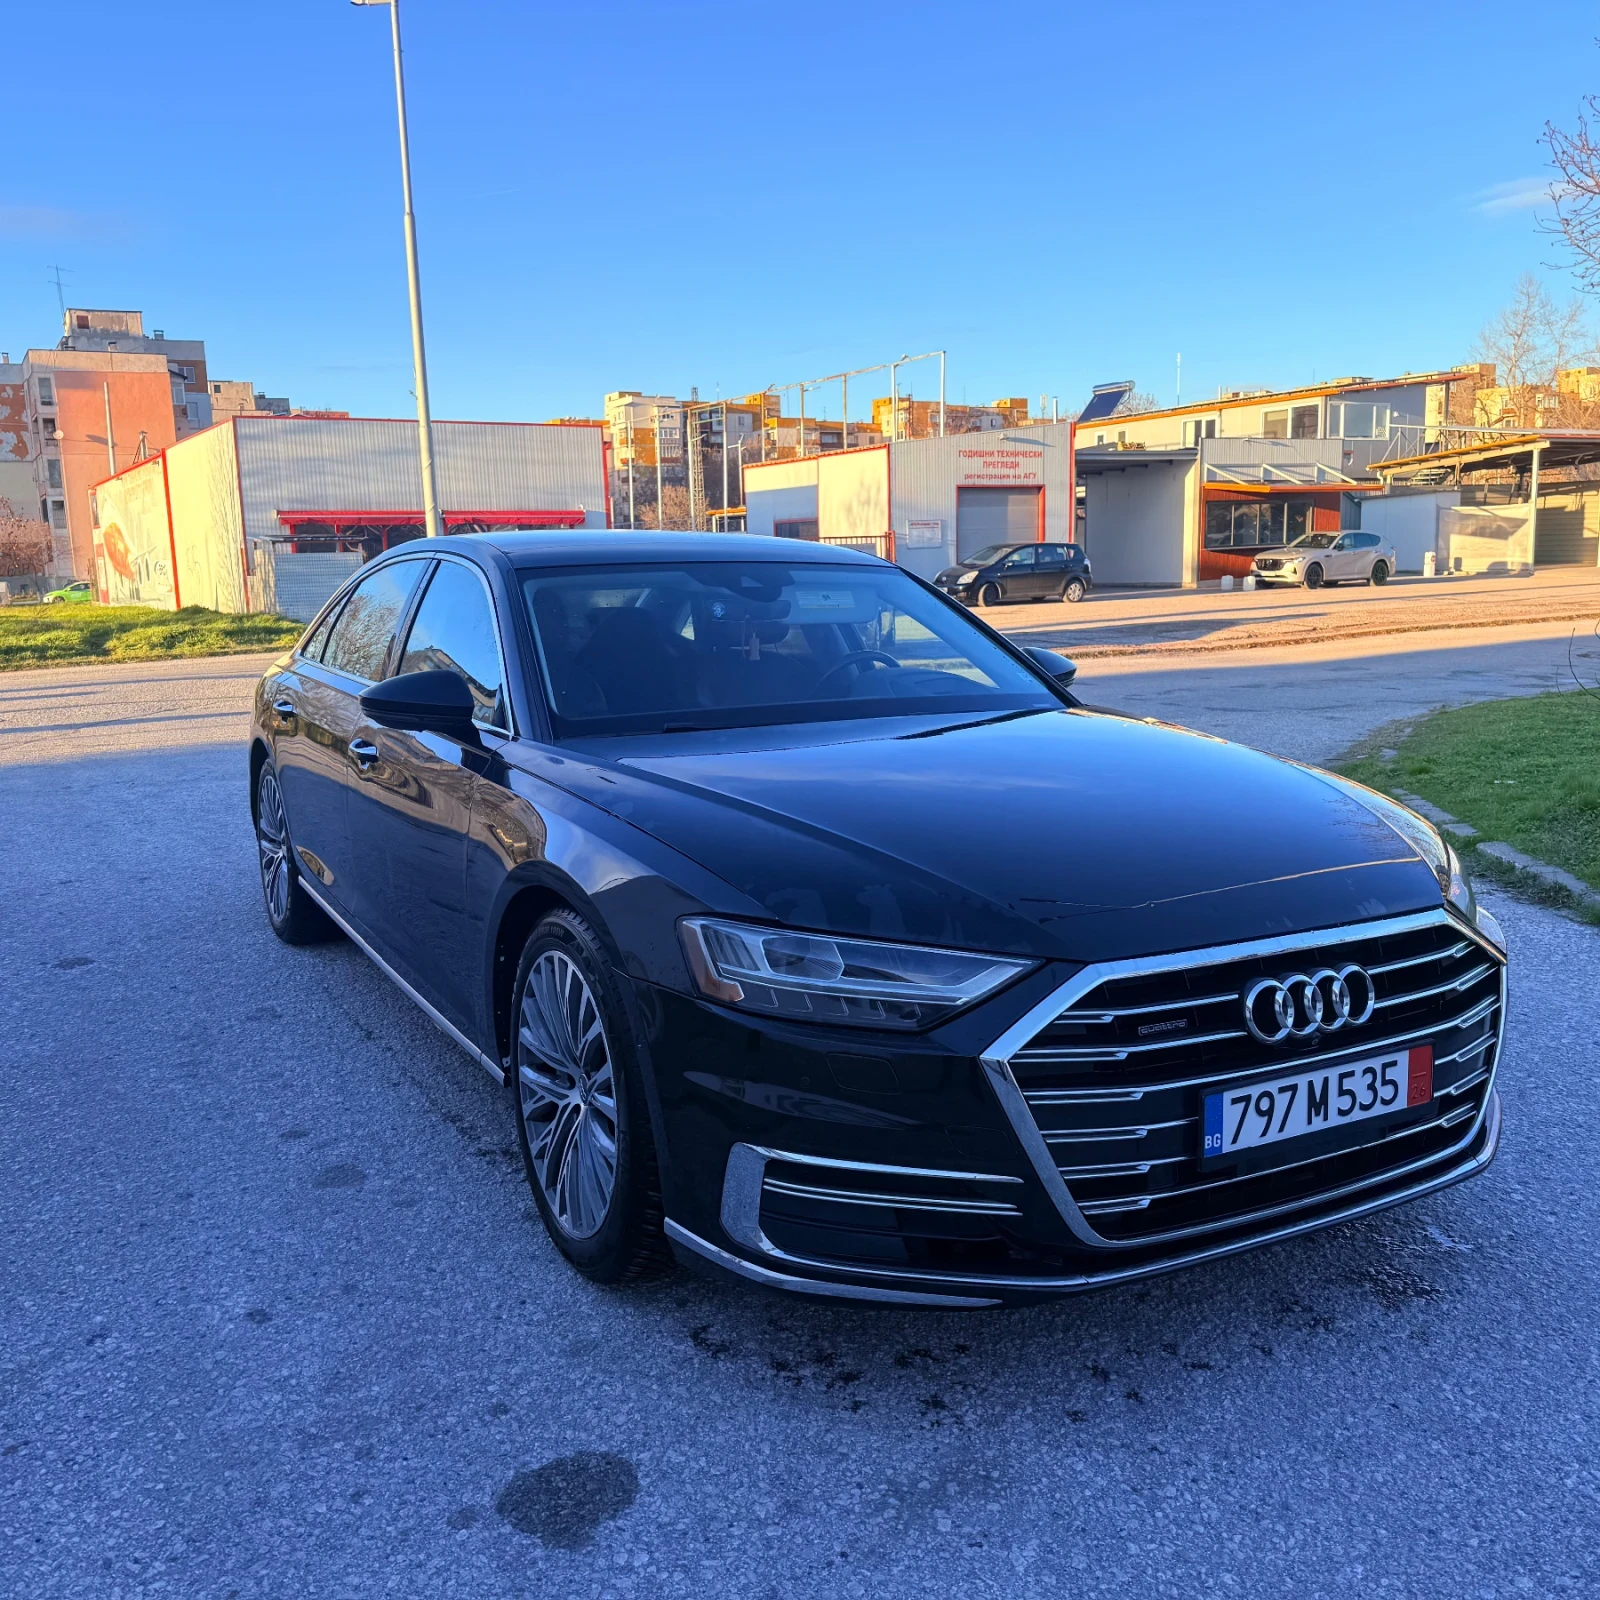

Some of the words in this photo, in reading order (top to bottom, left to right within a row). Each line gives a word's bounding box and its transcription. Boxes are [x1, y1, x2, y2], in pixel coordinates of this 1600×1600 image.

[958, 450, 994, 459] ГОДИШНИ
[997, 450, 1042, 458] ТЕХНИЧЕСКИ
[983, 461, 1019, 469] ПРЕГЛЕДИ
[1411, 1082, 1426, 1099] 26
[1204, 1133, 1221, 1149] BG
